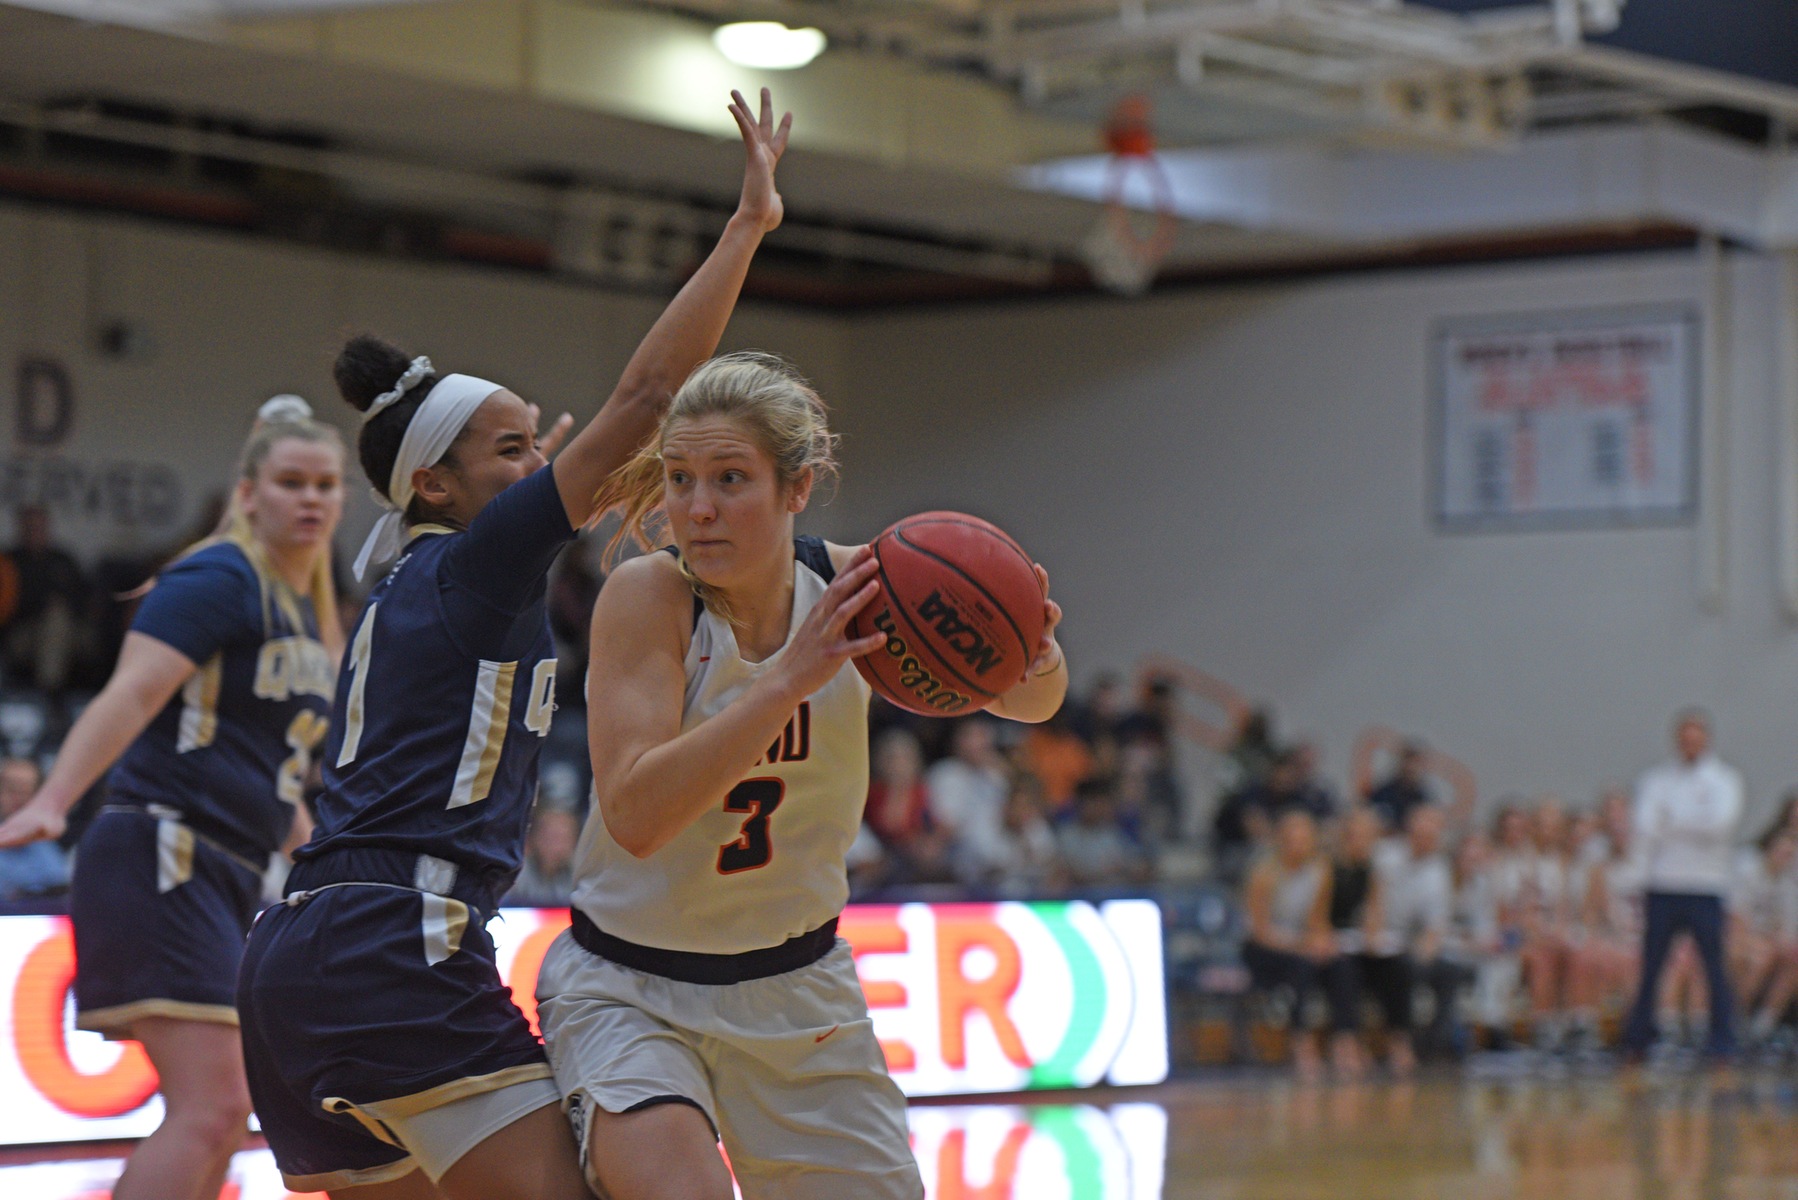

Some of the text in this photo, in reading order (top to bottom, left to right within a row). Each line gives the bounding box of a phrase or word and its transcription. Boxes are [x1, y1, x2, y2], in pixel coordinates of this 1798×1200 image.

[17, 361, 77, 447] D
[874, 608, 971, 711] Wilson
[917, 589, 1003, 677] NCAA
[336, 602, 377, 768] 1
[716, 776, 786, 875] 3
